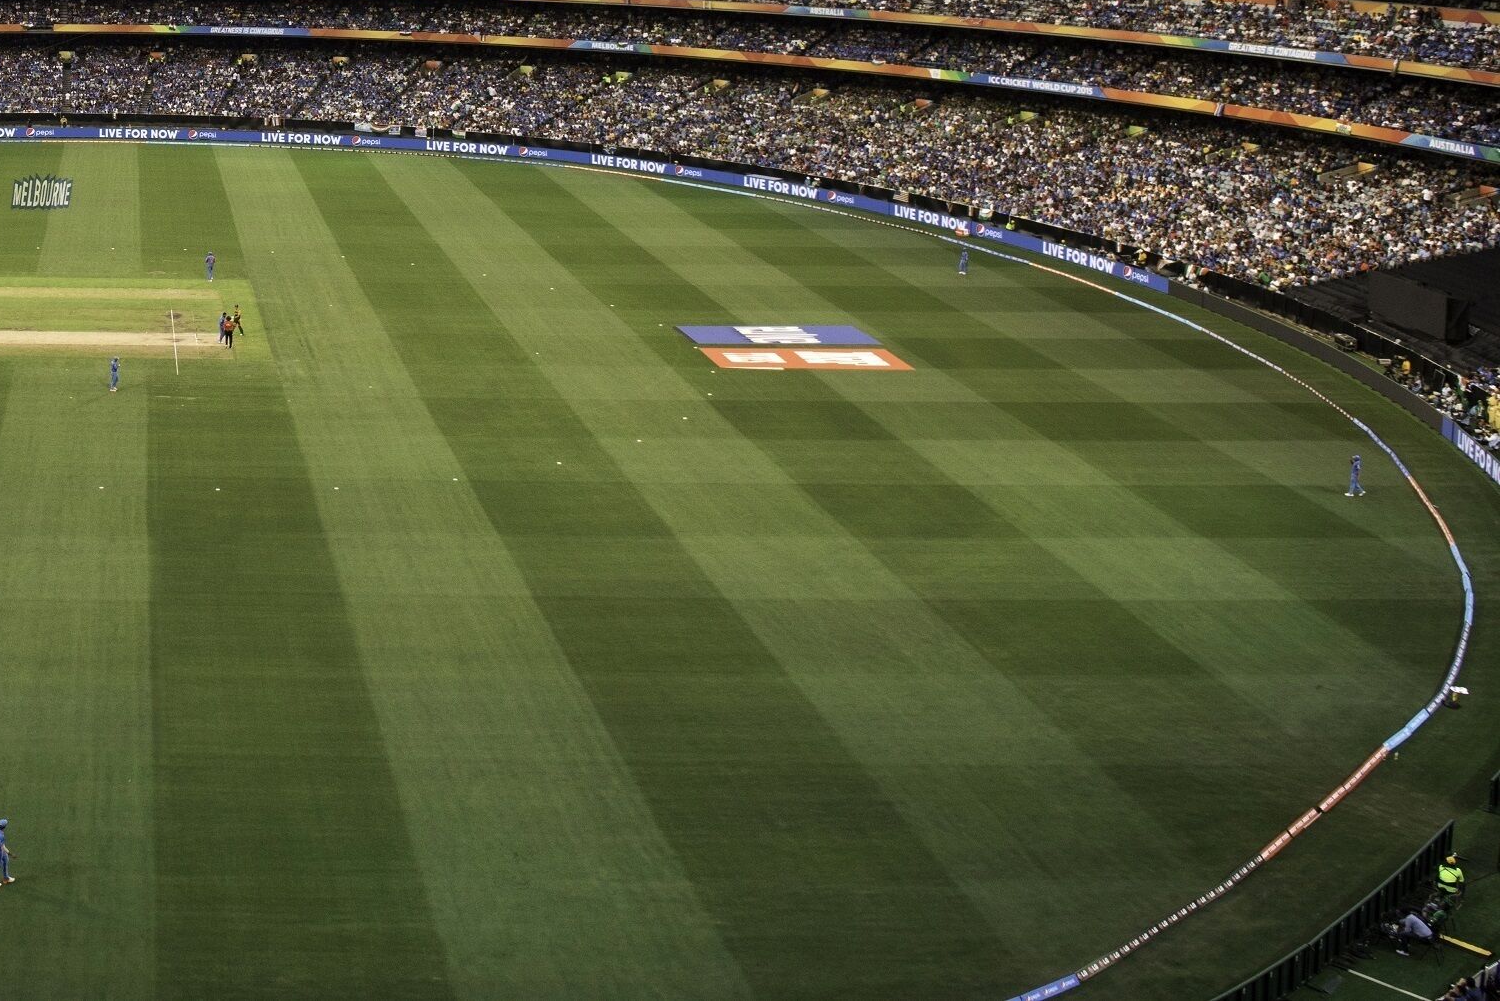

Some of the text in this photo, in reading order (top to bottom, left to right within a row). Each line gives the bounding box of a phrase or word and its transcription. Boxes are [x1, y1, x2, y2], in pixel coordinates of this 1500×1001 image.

[1001, 77, 1030, 88] CRICKET
[1032, 80, 1060, 91] WORLD
[1060, 84, 1076, 93] CUP
[1076, 86, 1092, 95] 2015
[99, 129, 178, 139] LIVE FOR NOW
[262, 133, 341, 145] LIVE FOR NOW
[426, 141, 508, 155] LIVE FOR NOW
[1429, 139, 1475, 155] AUSTRALIA
[591, 154, 665, 174] LIVE FOR NOW
[685, 169, 702, 177] pepsi
[12, 179, 71, 207] MELBOURNE
[743, 176, 817, 199] LIVE FOR NOW
[836, 195, 854, 204] pepsi
[894, 205, 968, 230] LIVE FOR NOW
[985, 228, 1002, 238] pepsi
[1042, 241, 1115, 274] LIVE FOR NOW
[1132, 271, 1149, 283] pepsi
[1458, 429, 1474, 459] LIVE
[1475, 444, 1492, 477] FOR
